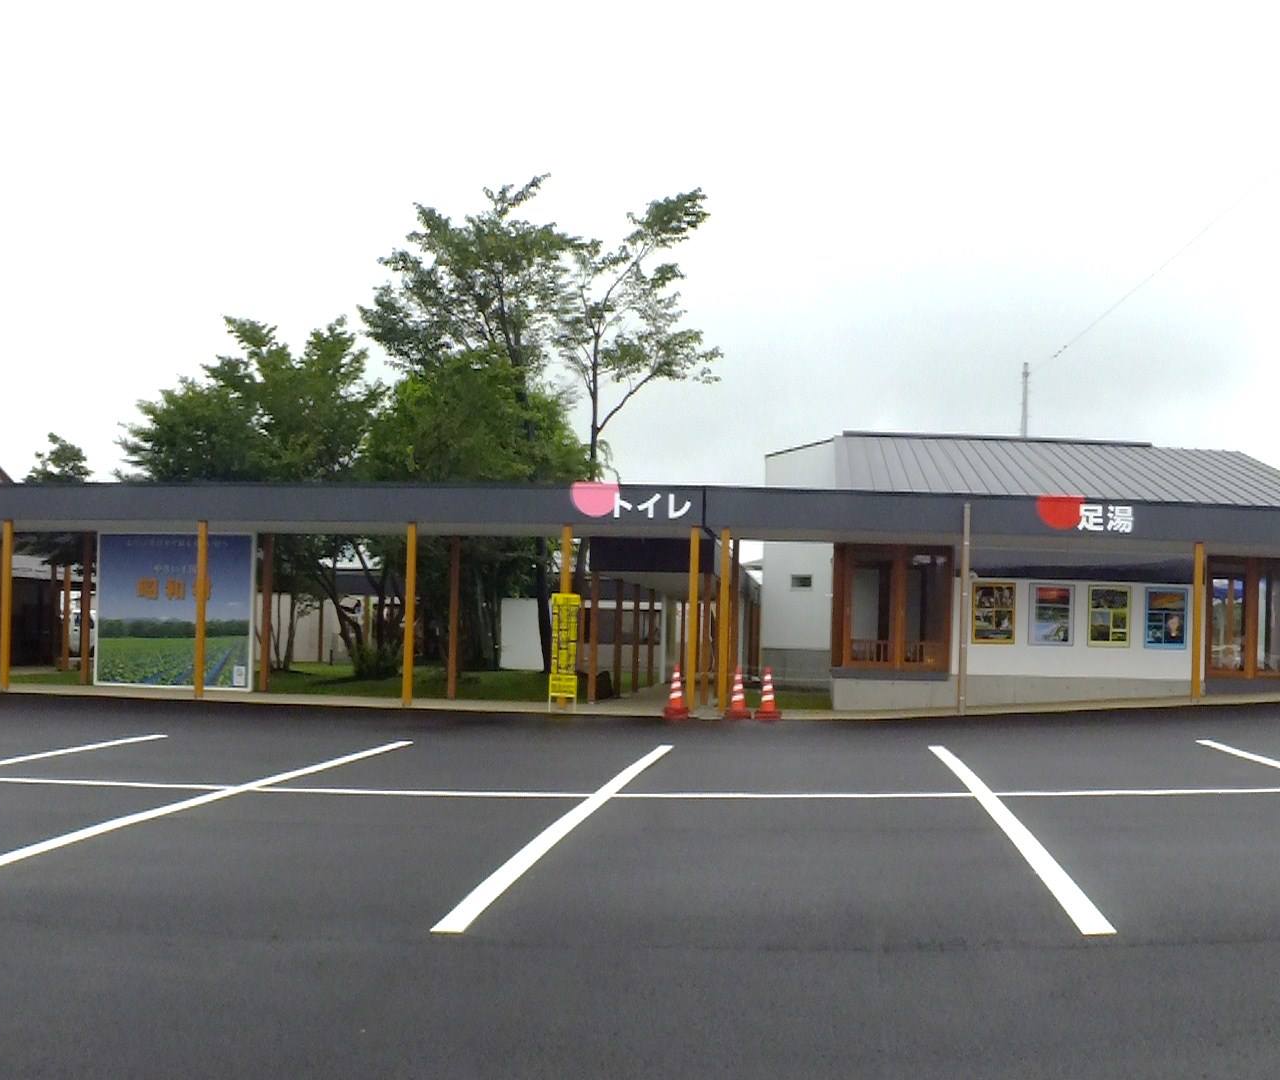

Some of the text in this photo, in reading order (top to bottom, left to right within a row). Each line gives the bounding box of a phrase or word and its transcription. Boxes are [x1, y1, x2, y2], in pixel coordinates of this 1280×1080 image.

[613, 492, 692, 519] トイレ
[1077, 503, 1135, 534] 足湯
